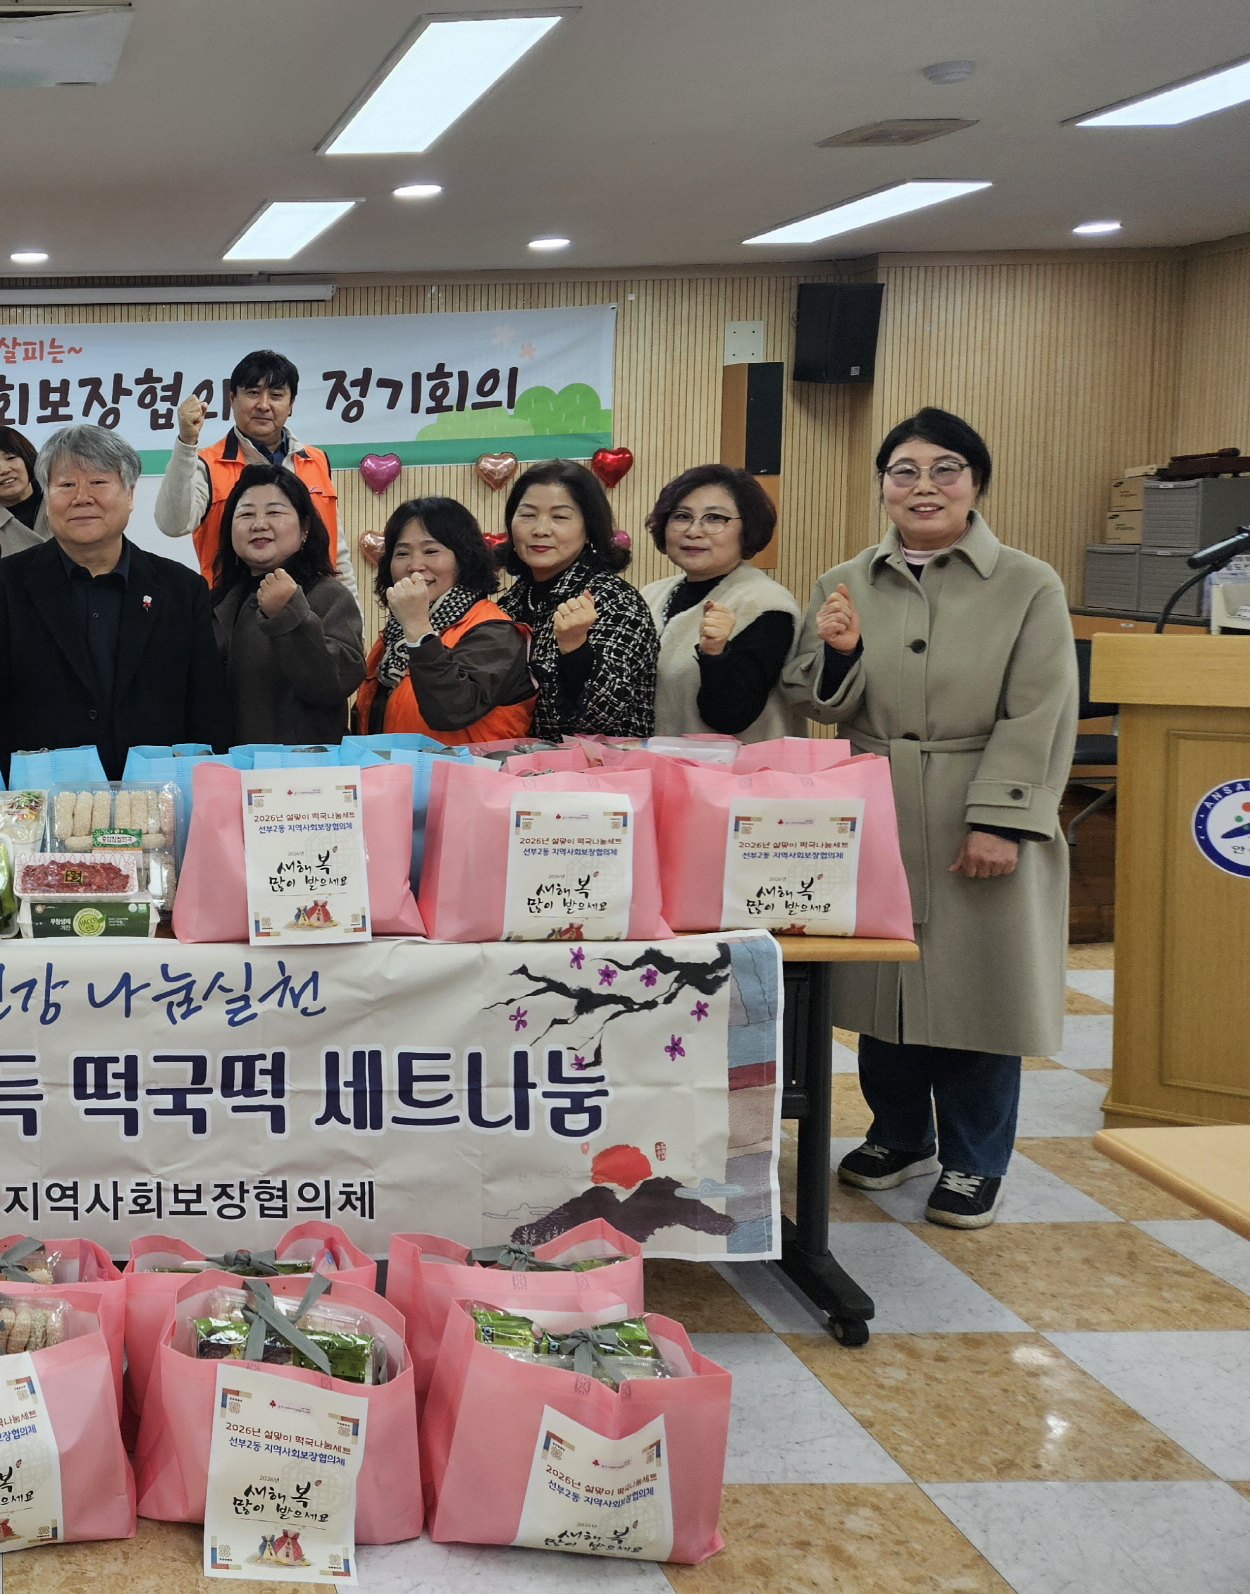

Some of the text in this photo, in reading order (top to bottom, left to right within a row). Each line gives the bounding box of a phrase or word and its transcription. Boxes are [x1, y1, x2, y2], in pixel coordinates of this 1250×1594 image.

[322, 362, 519, 423] 정기회의
[1204, 782, 1250, 809] ANSA
[254, 814, 284, 823] 2026년
[286, 813, 310, 821] 설맞이
[258, 822, 353, 833] 선부2동 지역사회보장협의체
[519, 837, 550, 846] 2026년
[552, 837, 576, 846] 설맞이
[523, 847, 618, 857] 선부2동 지역사회보장협의체
[739, 841, 771, 850] 2026년
[773, 841, 798, 850] 설맞이
[277, 850, 332, 875] 새해 복
[742, 851, 844, 861] 선부2동 지역사회보장협의체
[269, 875, 348, 892] 많이 받으세요
[536, 874, 591, 900] 새해 복
[756, 878, 815, 901] 새해 복
[527, 898, 607, 914] 많이 받으세요
[746, 900, 831, 916] 많이 받으세요
[88, 960, 328, 1028] 나눔실천
[72, 1051, 288, 1138] 떡국떡
[313, 1048, 609, 1139] 세트나눔
[3, 1179, 376, 1222] 지역사회보장협의체
[226, 1422, 261, 1438] 2026년
[264, 1430, 292, 1443] 설맞이
[229, 1437, 345, 1467] 선부2동 지역사회보장협의체
[545, 1465, 581, 1489] 2026년
[244, 1481, 311, 1508] 새해 복
[548, 1479, 580, 1503] 선부2동
[233, 1497, 328, 1522] 많이 받으세요
